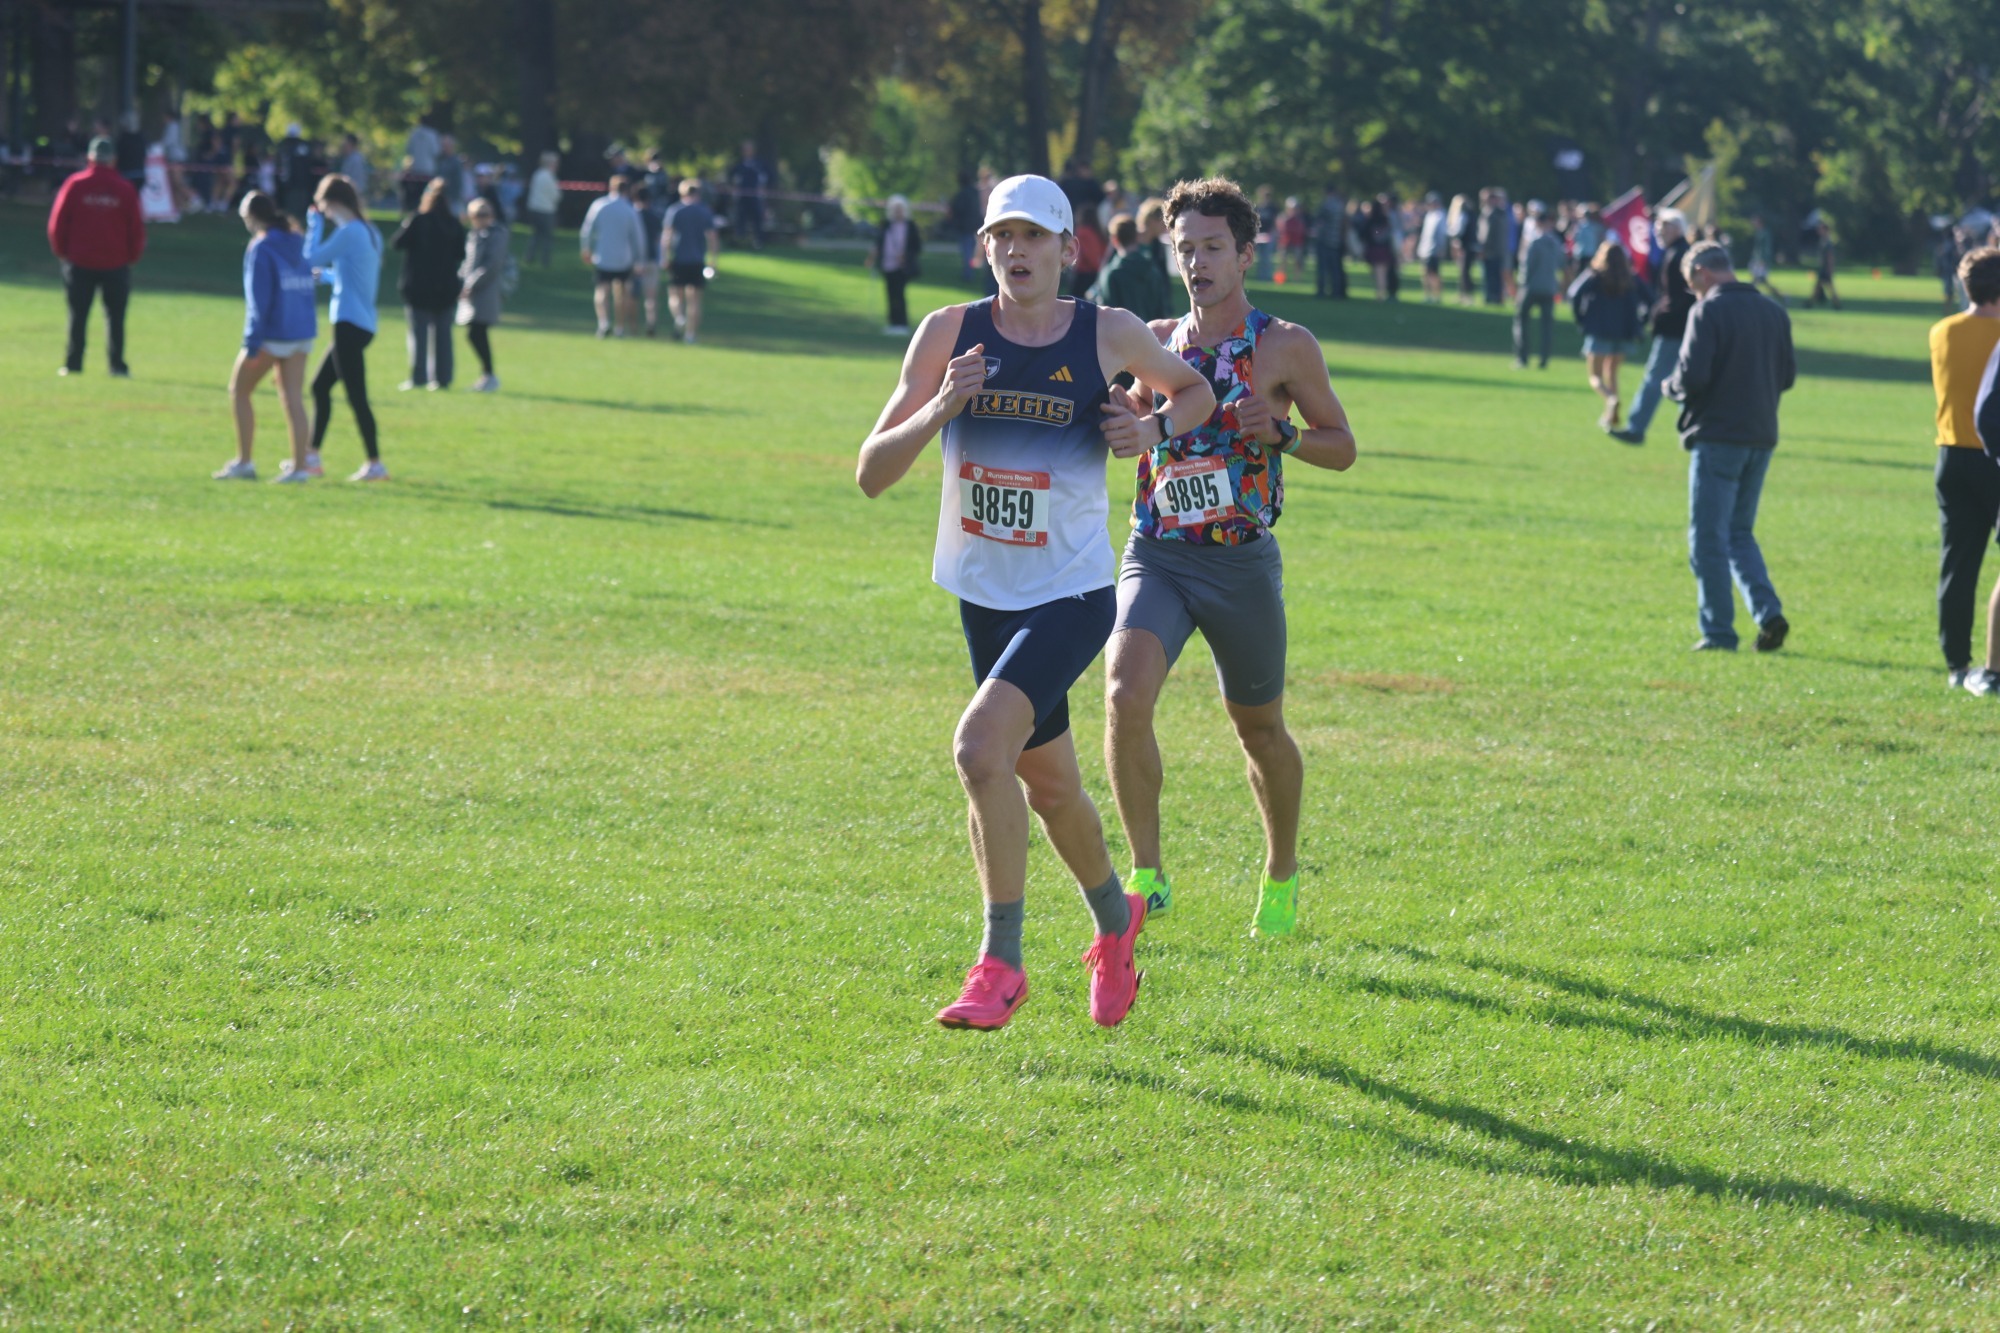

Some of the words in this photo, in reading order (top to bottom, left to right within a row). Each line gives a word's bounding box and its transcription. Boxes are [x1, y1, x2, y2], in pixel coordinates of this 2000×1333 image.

[972, 390, 1074, 426] REGIS
[987, 471, 1014, 480] Runners
[1014, 474, 1033, 482] Roost
[1165, 472, 1220, 513] 9895
[972, 483, 1034, 529] 9859
